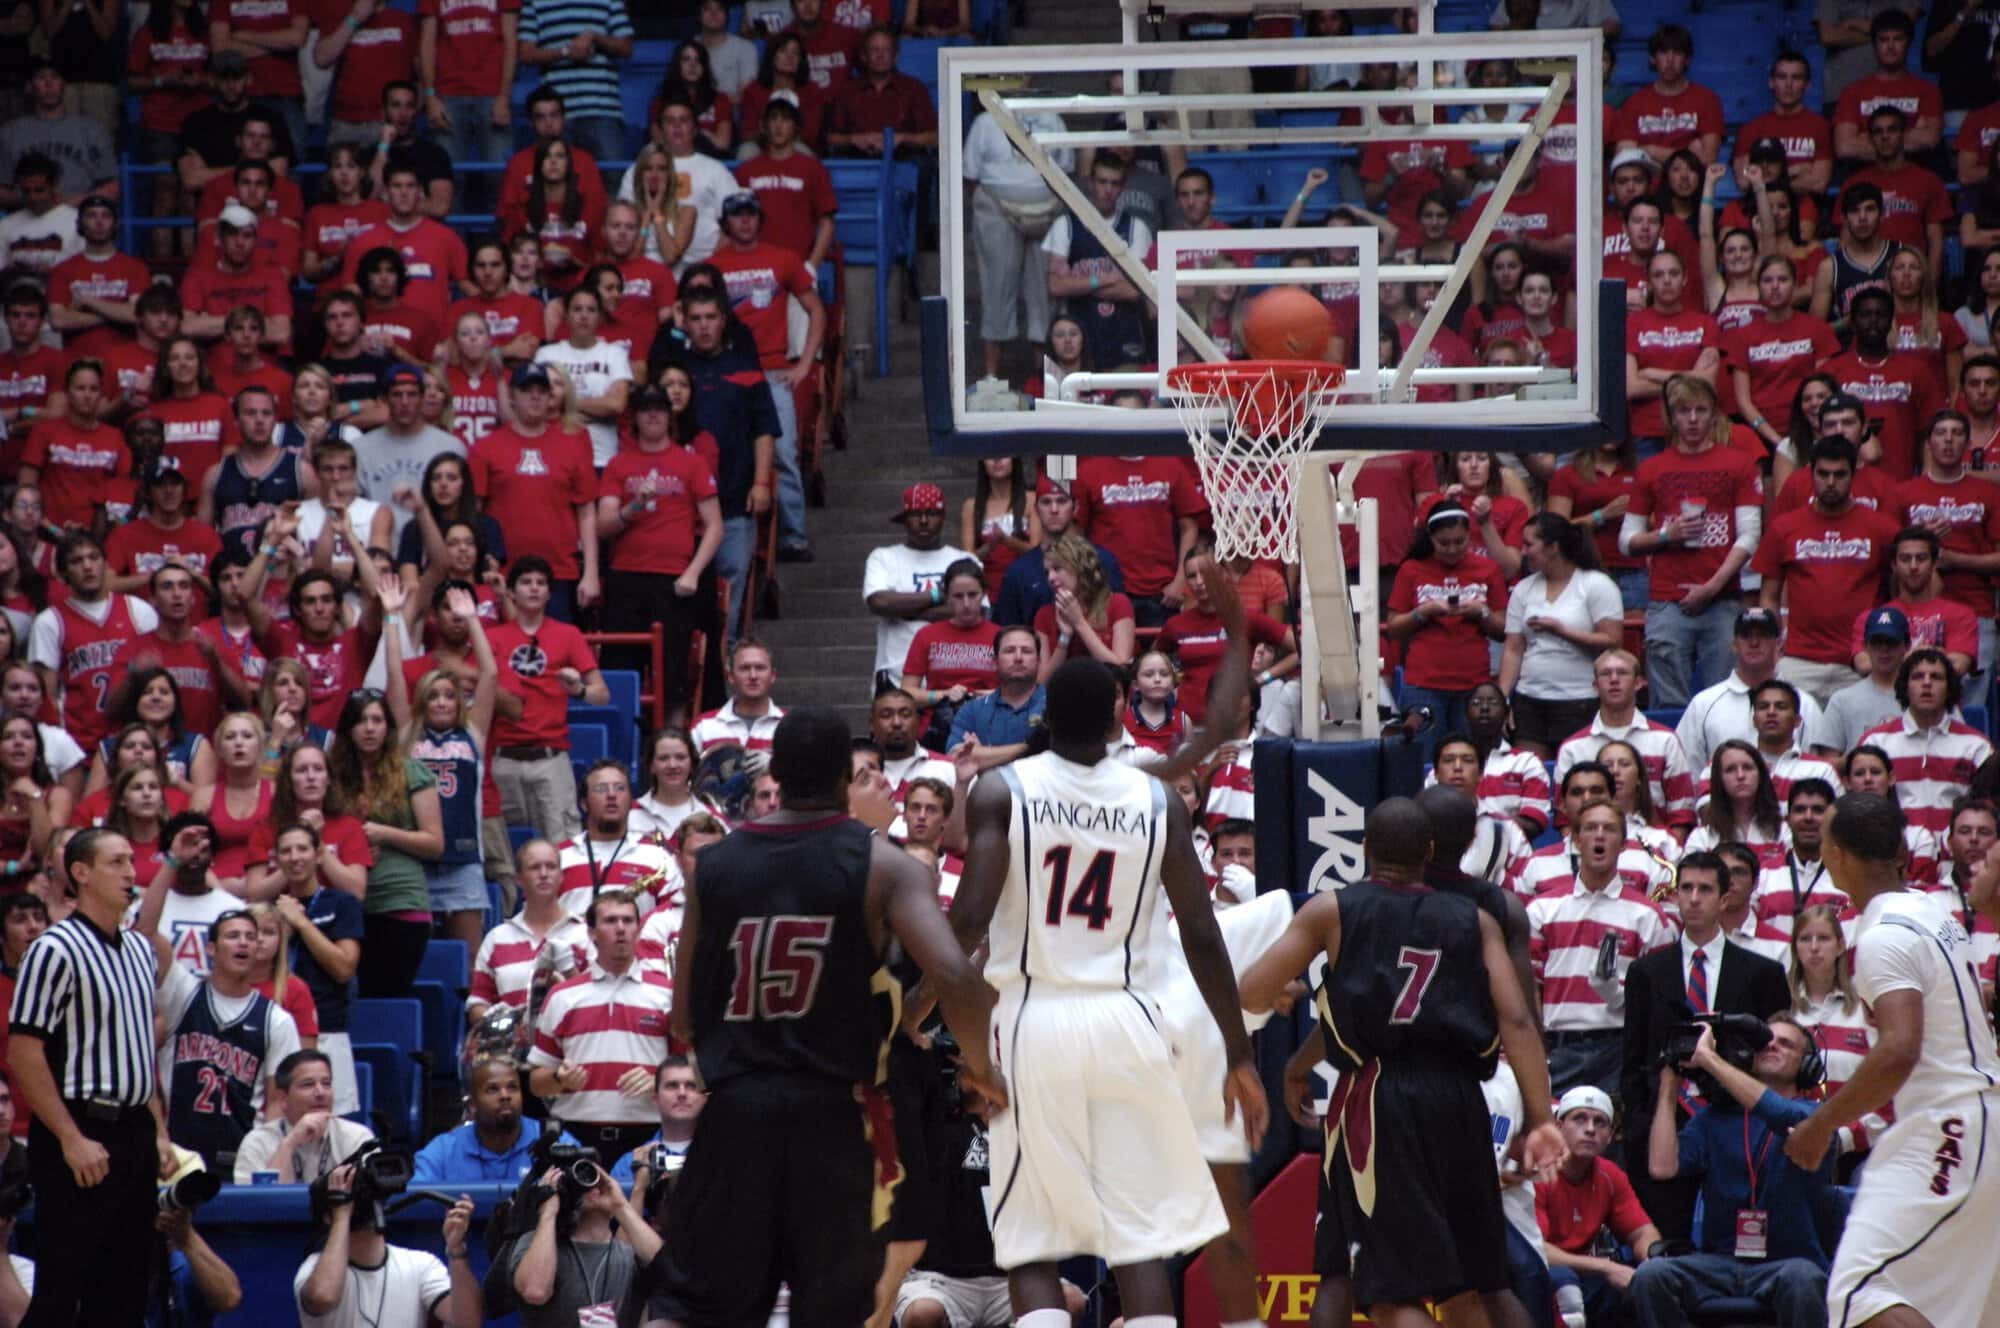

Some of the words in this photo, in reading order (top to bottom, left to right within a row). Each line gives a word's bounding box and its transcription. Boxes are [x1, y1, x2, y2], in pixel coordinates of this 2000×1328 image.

[1027, 796, 1148, 839] TANGARA
[1042, 843, 1117, 932] 14
[725, 914, 835, 1022] 15
[1389, 945, 1442, 1026] 7
[175, 1030, 260, 1088] ARIZONA
[1929, 1117, 1966, 1197] CATS
